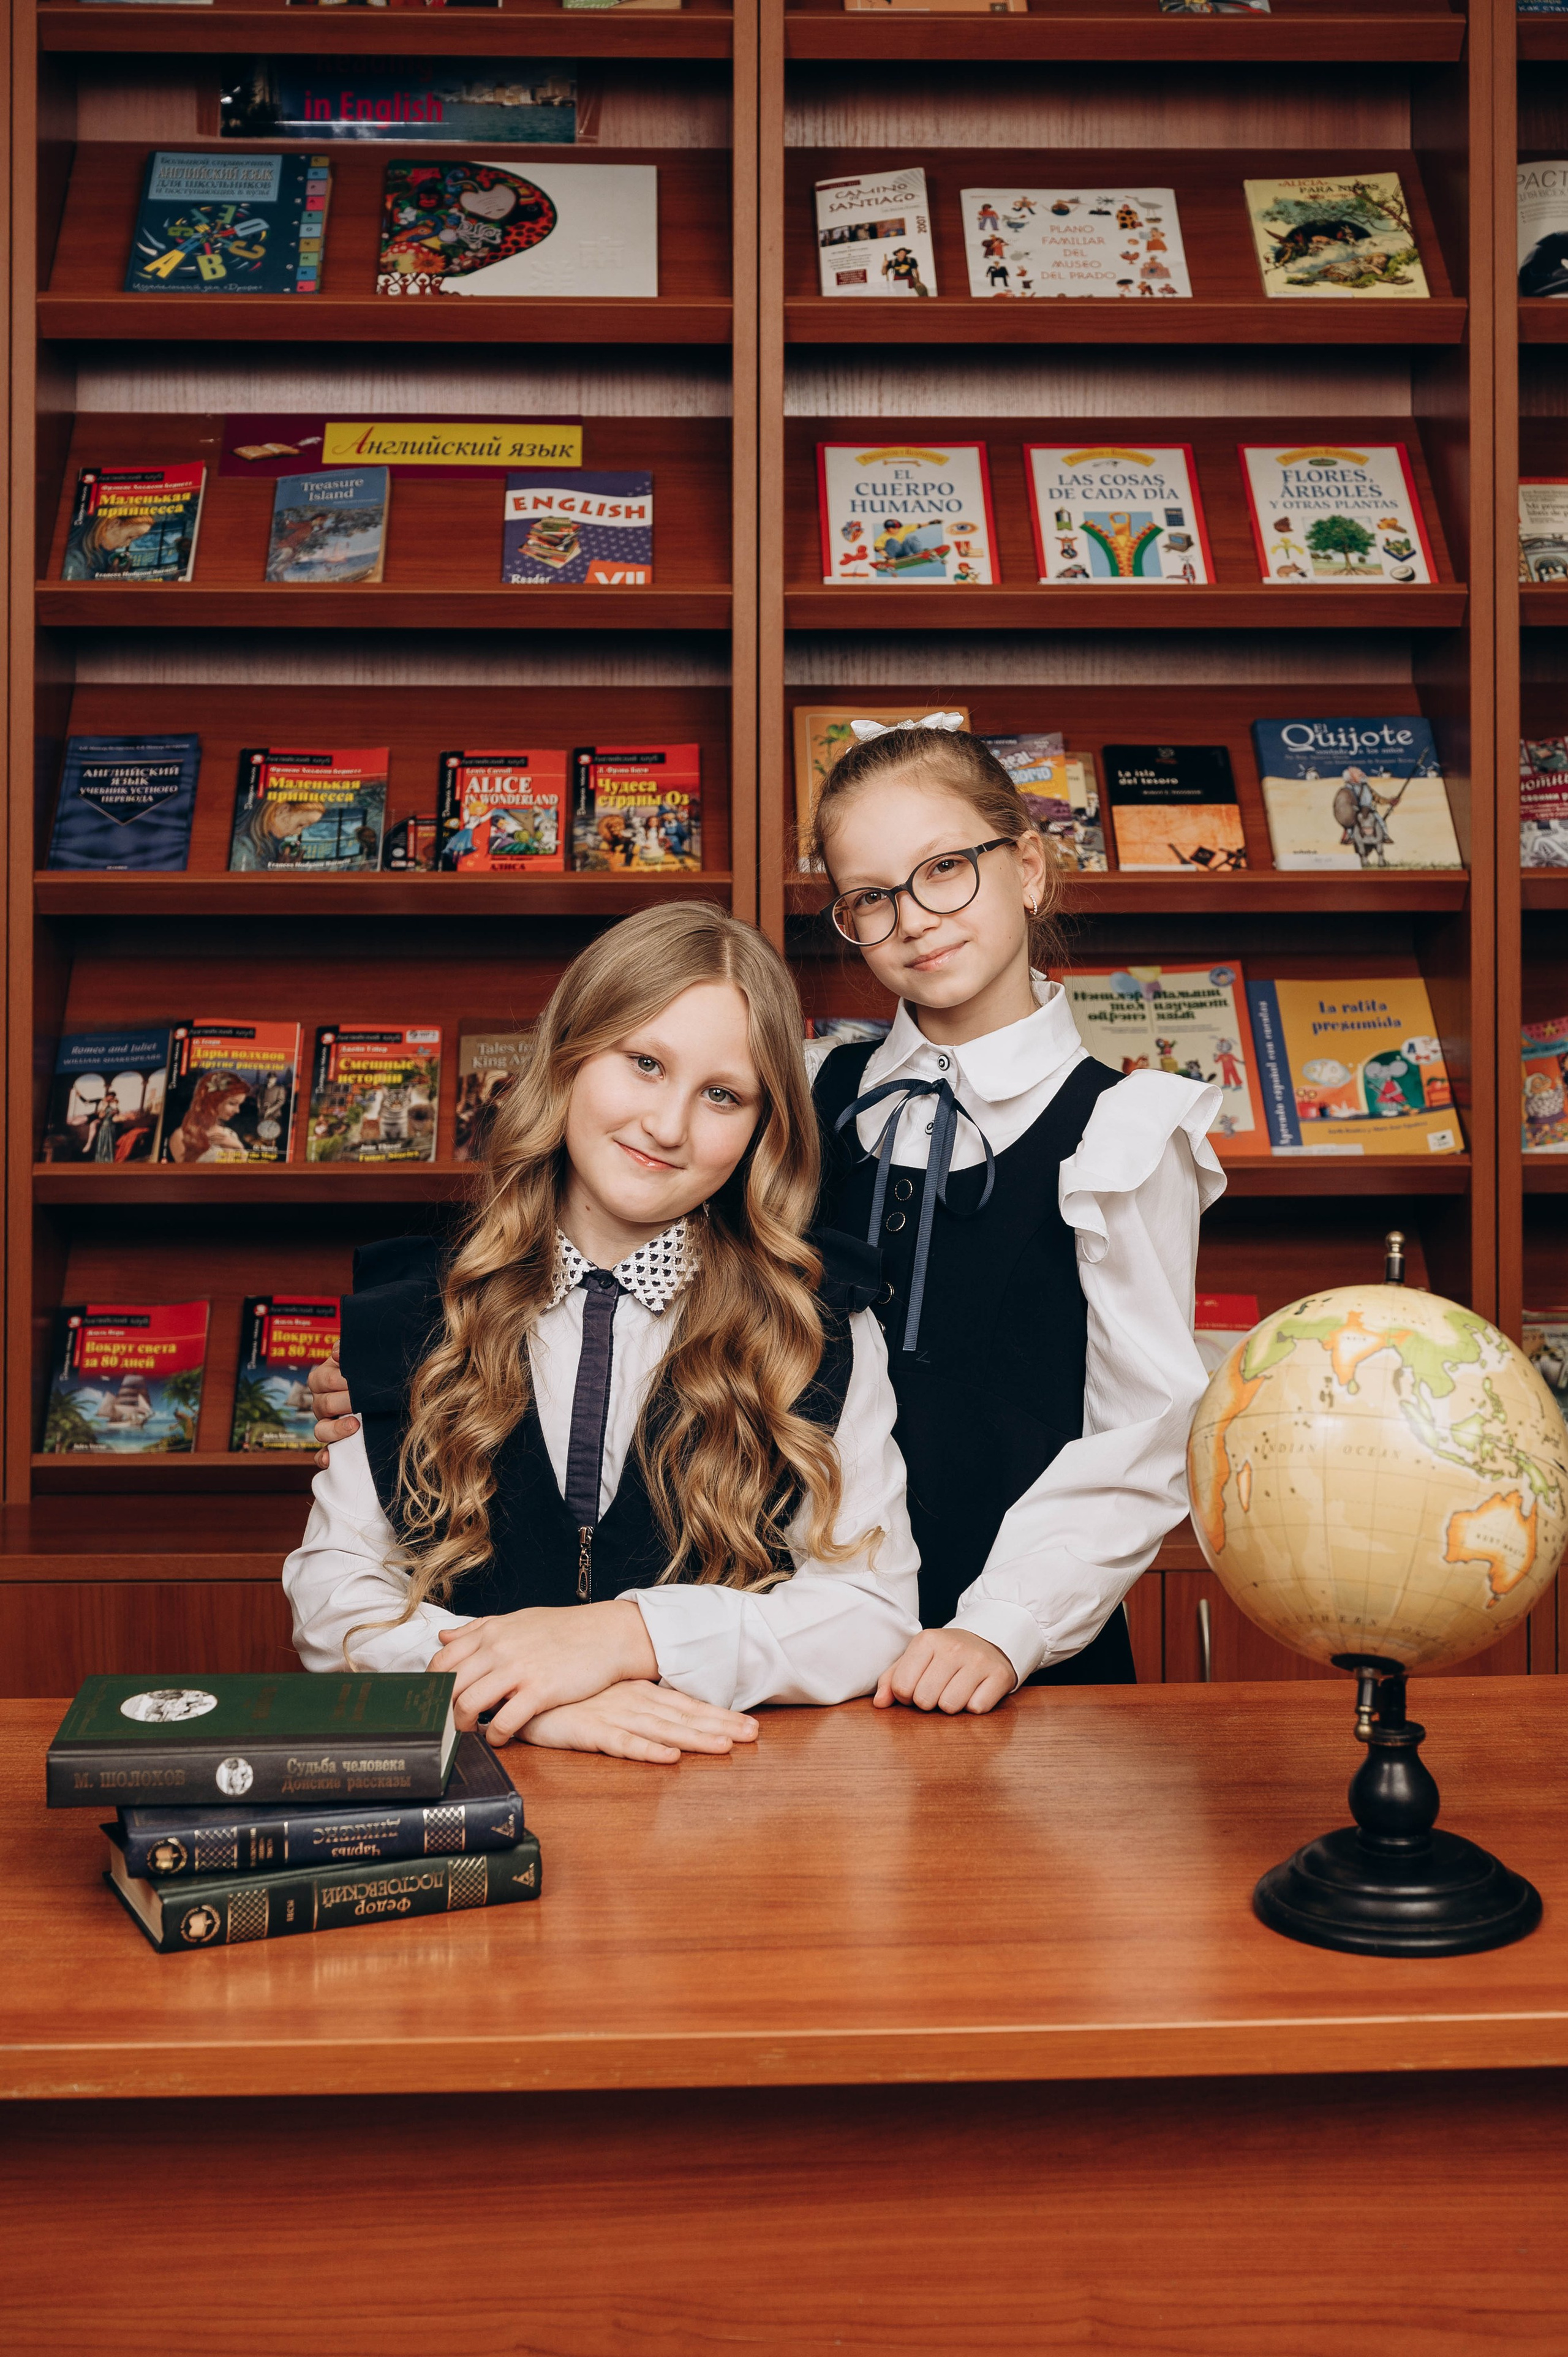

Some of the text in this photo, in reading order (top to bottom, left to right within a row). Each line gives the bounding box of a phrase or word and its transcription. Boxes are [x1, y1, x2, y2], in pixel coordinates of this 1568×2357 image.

[304, 91, 443, 130] in English
[158, 165, 273, 181] АНГЛИЙСКИЙ ЯЗЫК
[185, 181, 271, 189] ШКОЛЬНИКОВ
[835, 183, 908, 199] CAMINO
[829, 192, 915, 213] SANTIAGO
[1050, 225, 1095, 233] PLANO
[1041, 236, 1105, 245] FAMILIAR
[1063, 248, 1087, 257] DEL
[1041, 271, 1117, 280] DEL PRADO
[331, 426, 575, 459] Английский язык
[894, 469, 914, 480] EL
[1058, 473, 1166, 486] LAS COSAS
[1281, 469, 1374, 483] FLORES,
[300, 478, 364, 492] Treasure
[854, 482, 955, 496] CUERPO
[1280, 480, 1383, 498] ÁRBOLES
[99, 492, 192, 505] Маленькая
[309, 488, 355, 502] Island
[1048, 485, 1180, 500] DE CADA DÍA
[97, 504, 184, 518] принцесса
[513, 496, 645, 519] ENGLISH
[850, 498, 963, 513] HUMANO
[1269, 499, 1398, 509] Y OTRAS PLANTAS
[511, 573, 552, 585] Reader
[594, 571, 646, 585] VII
[1281, 723, 1414, 756] Quijote
[83, 765, 179, 778] АНГЛИЙСКИЙ
[1134, 769, 1156, 777] isla
[110, 777, 149, 786] ЯЗЫК
[268, 776, 361, 790] Маленькая
[465, 776, 533, 794] ALICE
[597, 777, 657, 794] Чудеса
[1118, 777, 1179, 786] del tesoro
[80, 785, 179, 795] УЧЕБНИК УСТНОГО
[101, 795, 154, 804] ПЕРЕВОДА
[267, 791, 355, 804] принцесса
[480, 793, 559, 805] WONDERLAND
[598, 790, 690, 809] страны Оз
[1319, 1000, 1387, 1014] La ratita
[1311, 1017, 1401, 1035] presumida
[71, 1045, 106, 1055] Romeo
[108, 1044, 129, 1054] and
[192, 1047, 285, 1061] Дары волхвов
[477, 1041, 514, 1056] Tales
[200, 1061, 235, 1071] другие
[236, 1062, 285, 1071] рассказы
[339, 1057, 415, 1071] Смешные
[472, 1055, 508, 1069] King
[338, 1073, 403, 1086] истории
[272, 1330, 322, 1345] Вокруг
[85, 1341, 177, 1355] Вокруг света
[271, 1346, 285, 1357] за
[288, 1344, 306, 1357] 80
[83, 1355, 156, 1369] за 80 дней
[287, 1756, 405, 1776] Судьба человека
[74, 1768, 186, 1789] М. ШОЛОХОВ
[281, 1774, 412, 1793] Донские рассказы
[312, 1817, 401, 1845] ДИККЕНС
[331, 1841, 382, 1858] Чарльз
[321, 1870, 445, 1909] ДОСТОЕВСКИЙ
[354, 1896, 411, 1917] Федор
